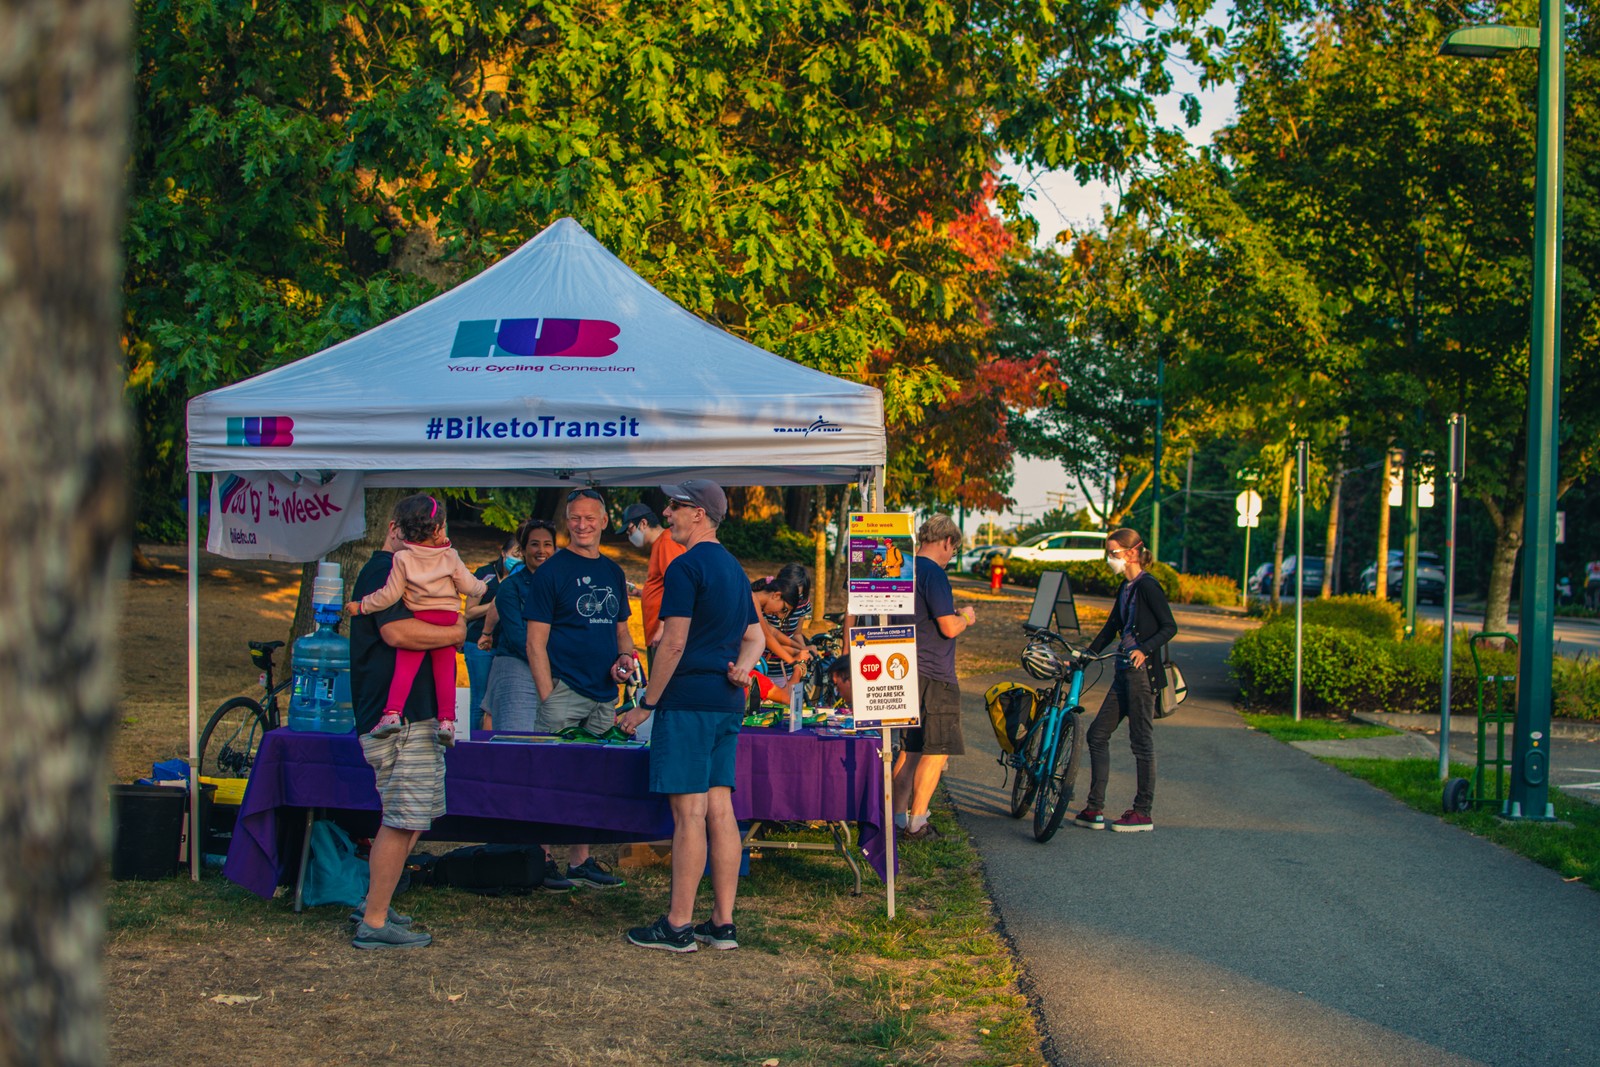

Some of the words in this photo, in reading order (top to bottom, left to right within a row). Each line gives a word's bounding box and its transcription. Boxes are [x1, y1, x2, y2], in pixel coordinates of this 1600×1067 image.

[450, 318, 621, 358] HUB
[485, 364, 544, 373] Cycling
[549, 364, 635, 373] Connection
[227, 416, 294, 447] HUB
[426, 415, 640, 440] #BiketoTransit
[862, 664, 880, 672] STOP
